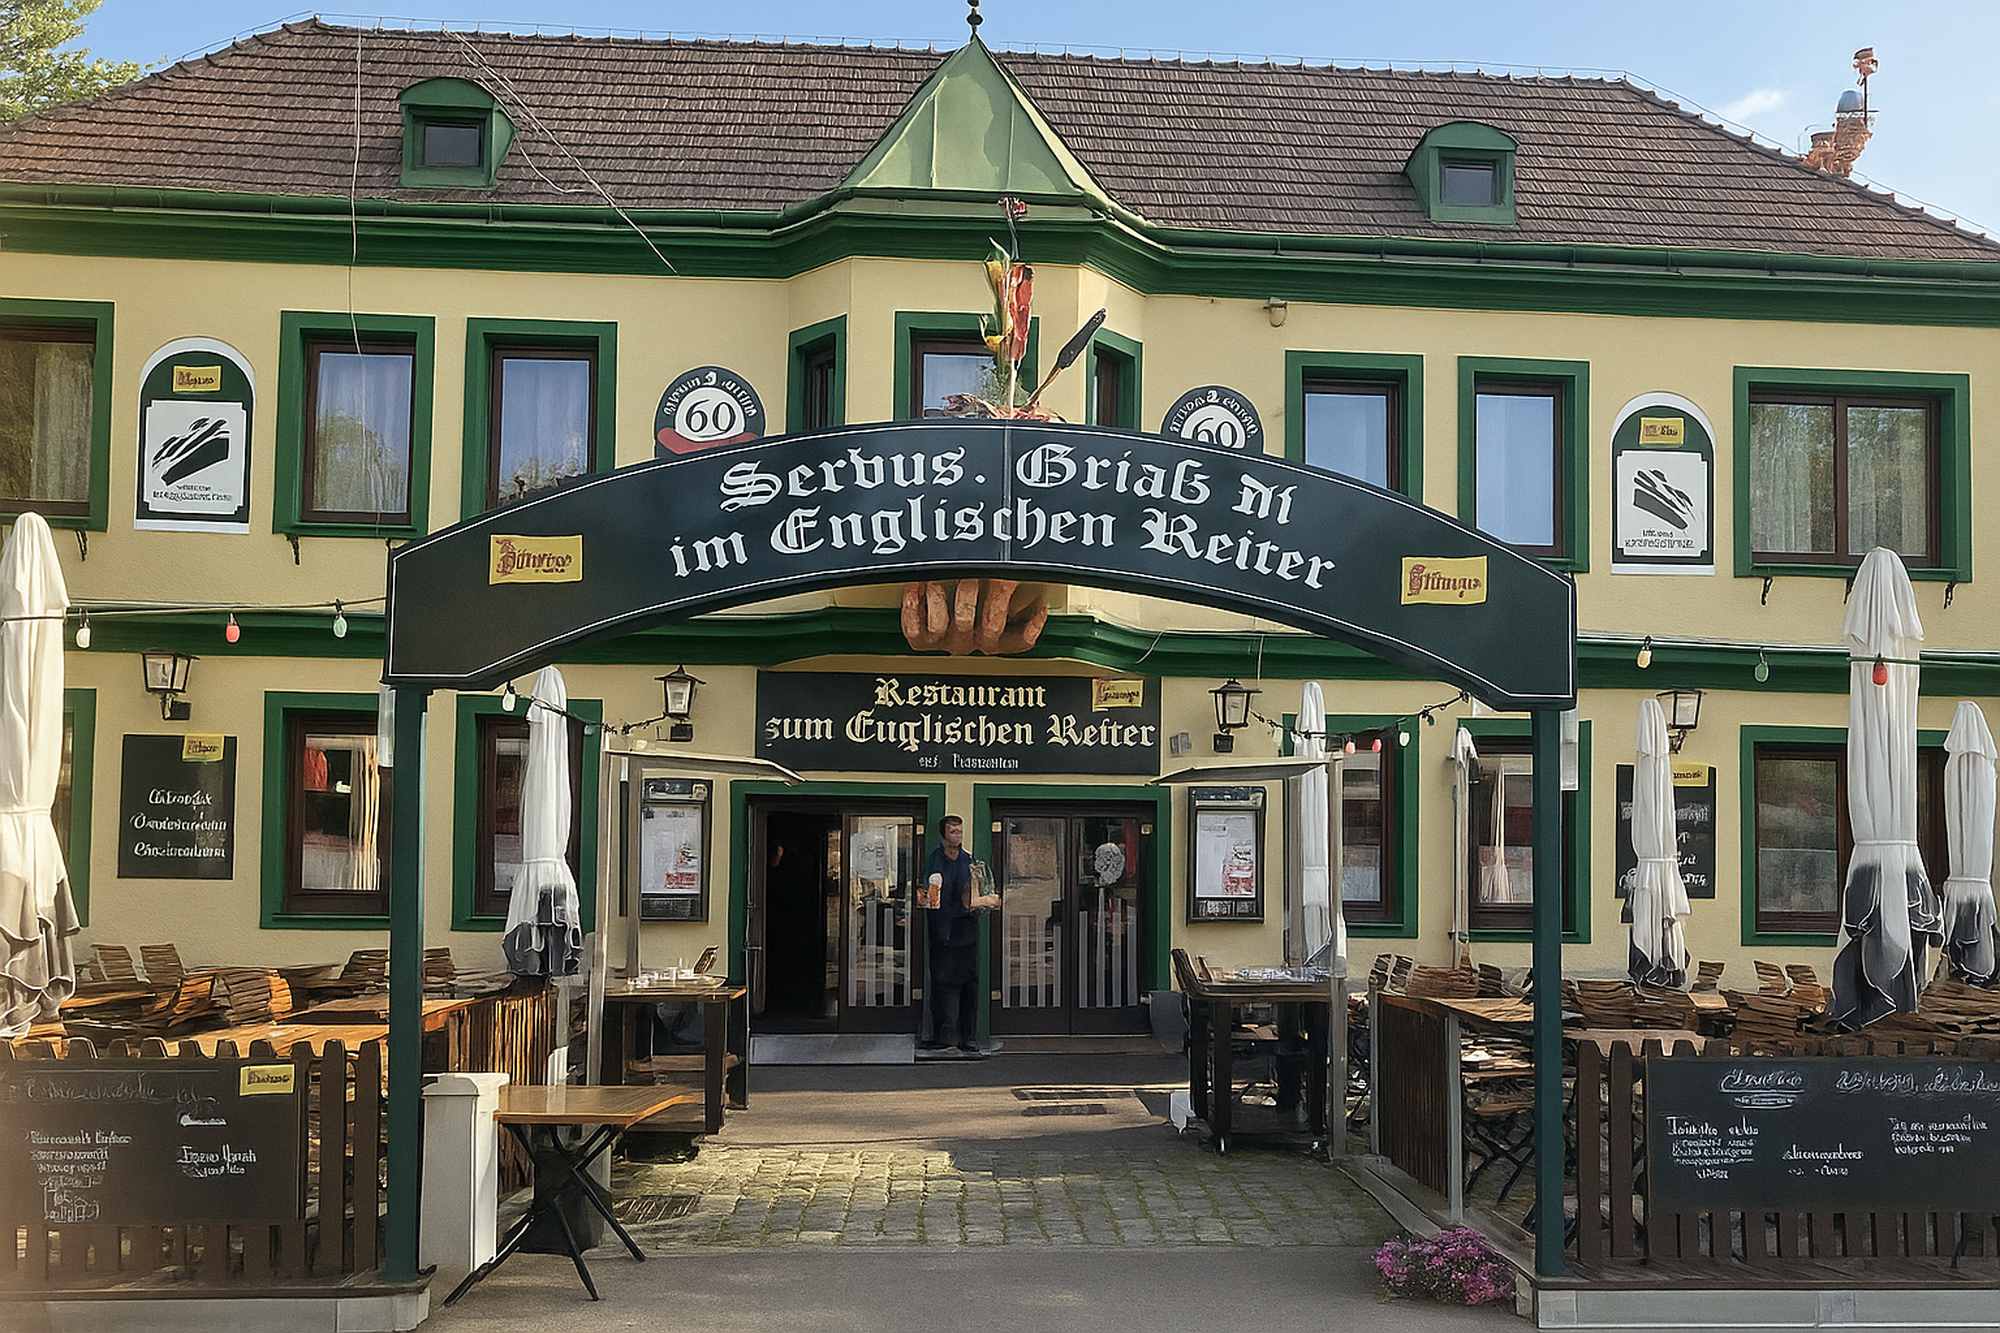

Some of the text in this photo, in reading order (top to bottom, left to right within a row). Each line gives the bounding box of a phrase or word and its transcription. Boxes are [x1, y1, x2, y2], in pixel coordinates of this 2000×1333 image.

[685, 398, 736, 433] 60
[1192, 417, 1238, 448] 60
[669, 530, 749, 578] im
[770, 494, 1117, 555] Englischen
[1140, 507, 1336, 589] Reiter
[874, 677, 1047, 708] Restaurant
[764, 708, 1156, 753] zum Englischen Reiter
